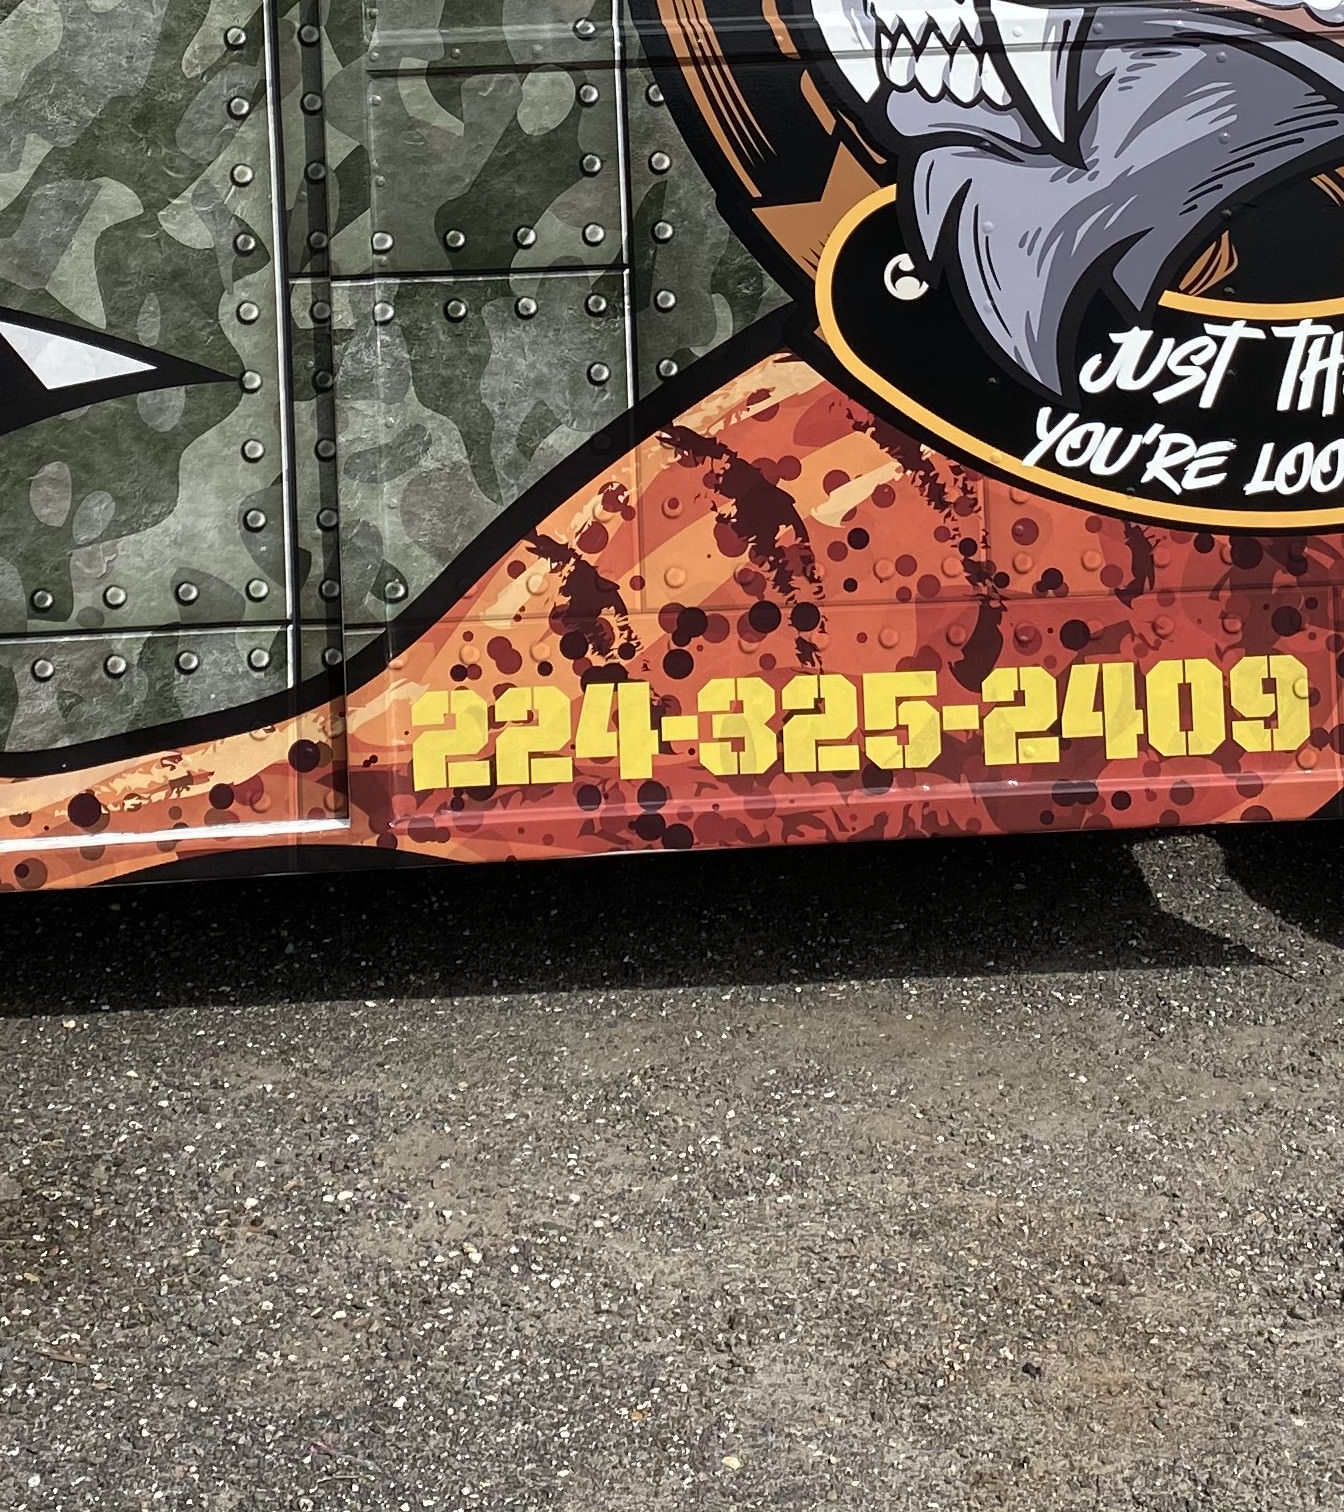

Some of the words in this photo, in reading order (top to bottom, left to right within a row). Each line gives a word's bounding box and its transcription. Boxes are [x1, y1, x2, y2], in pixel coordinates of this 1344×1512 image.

[1078, 318, 1268, 409] JUST
[1022, 406, 1238, 496] YOU'RE
[411, 655, 1311, 790] 224-325-2409
